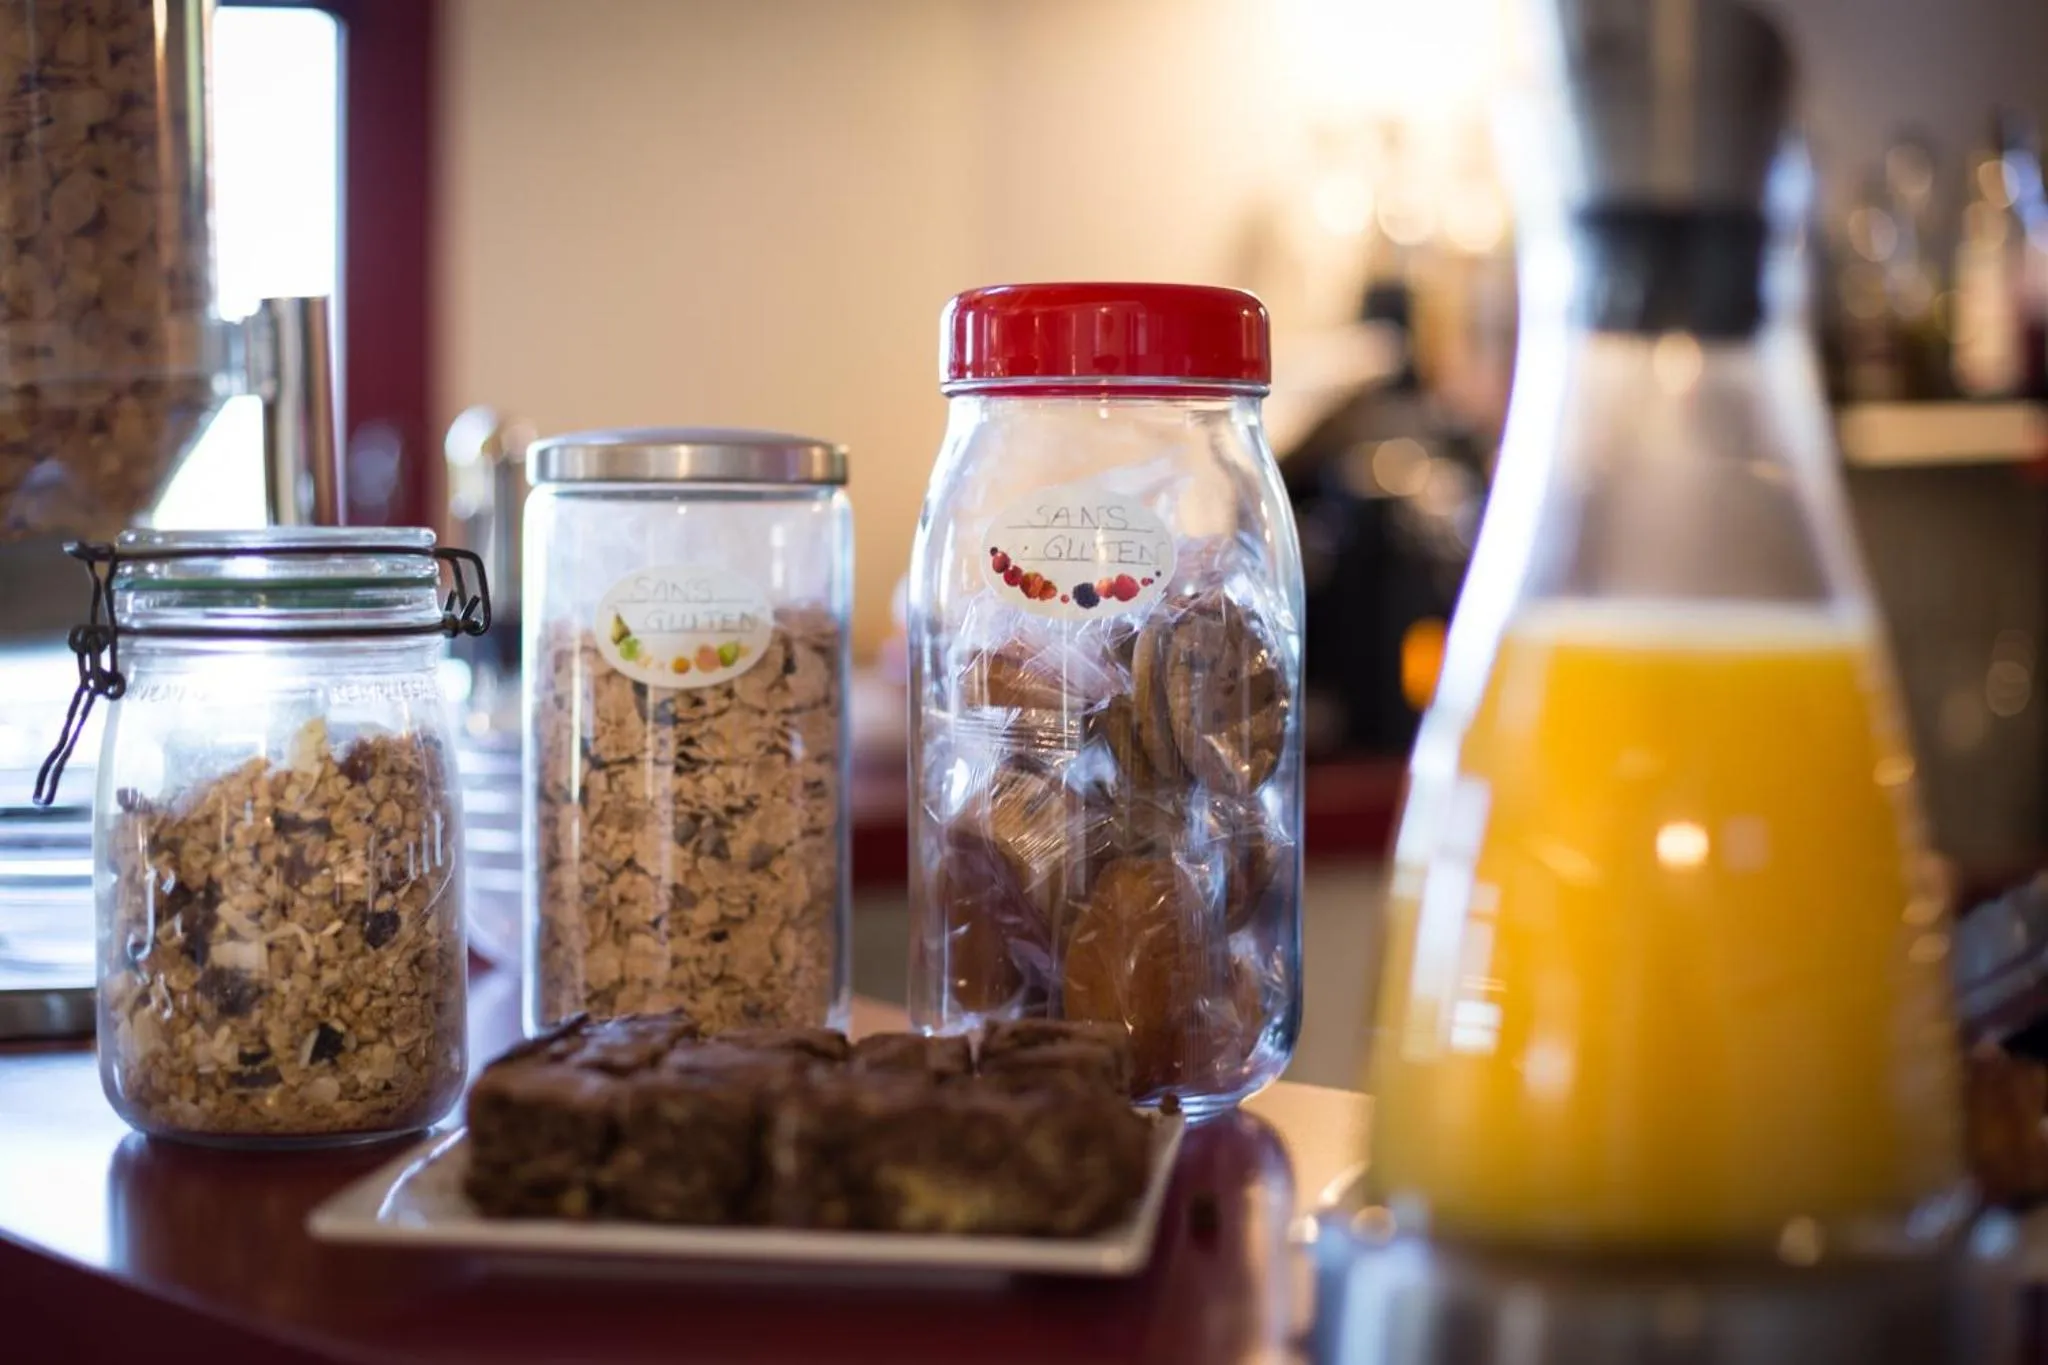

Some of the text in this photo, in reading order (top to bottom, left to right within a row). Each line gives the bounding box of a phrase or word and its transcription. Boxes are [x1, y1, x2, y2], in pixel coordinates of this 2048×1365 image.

[1027, 504, 1130, 530] SANS
[1043, 534, 1167, 565] GLUTEN
[629, 576, 715, 602] SANS
[644, 608, 766, 633] GLUTEN
